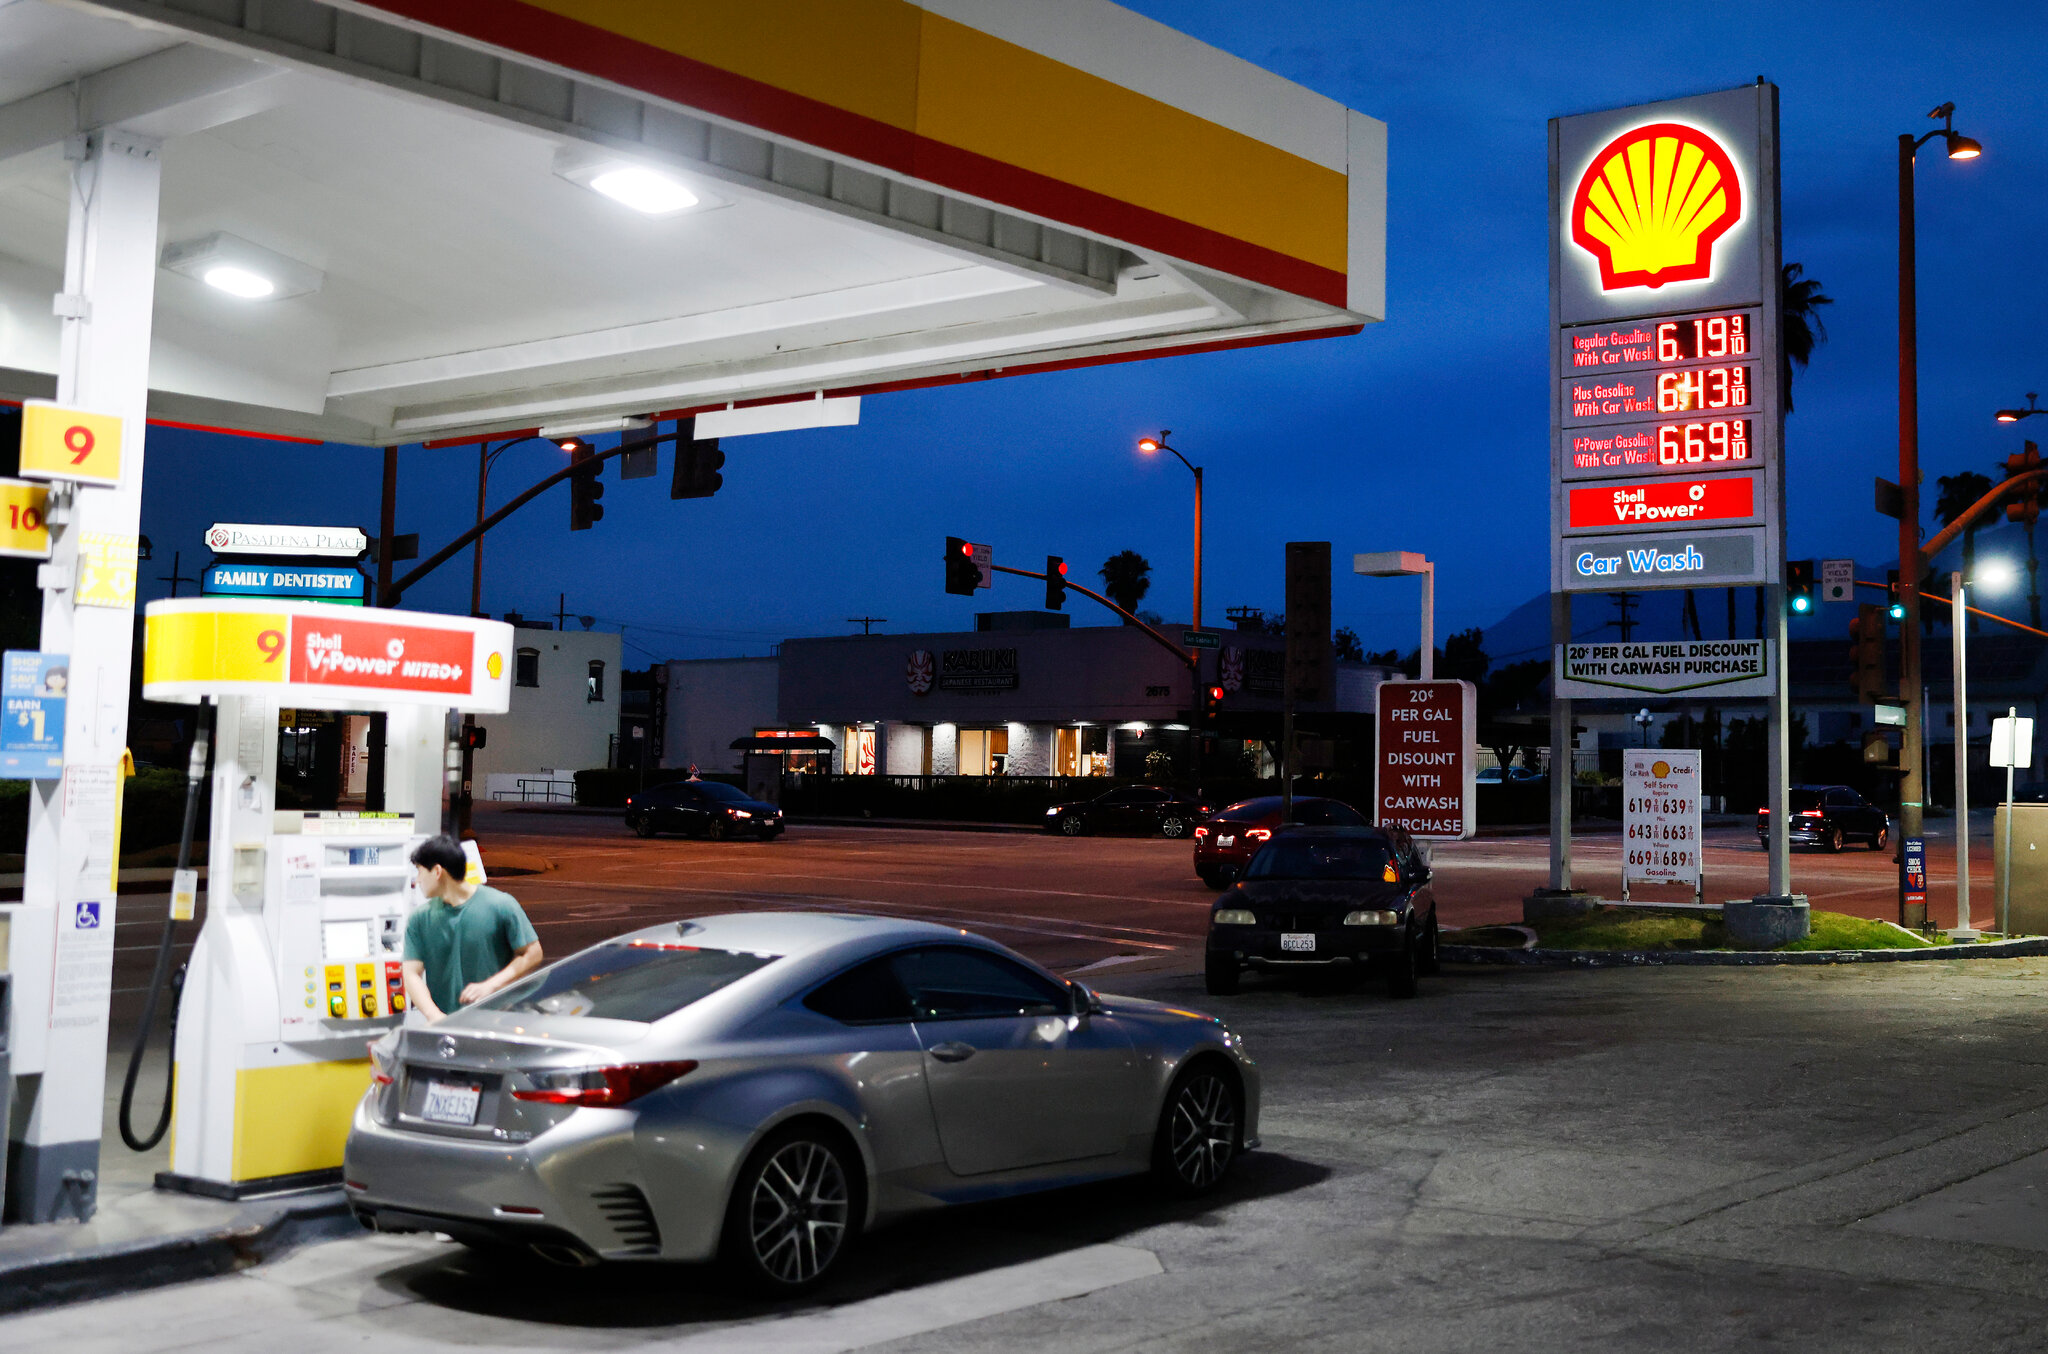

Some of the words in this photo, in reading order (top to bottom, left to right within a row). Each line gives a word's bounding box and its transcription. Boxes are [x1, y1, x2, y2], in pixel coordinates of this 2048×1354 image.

[1573, 335, 1608, 352] Regular
[1610, 329, 1652, 345] Gasoline
[1573, 352, 1599, 367] With
[1602, 351, 1620, 364] Car
[1623, 346, 1654, 362] Wash
[1573, 385, 1592, 400] Plus
[1594, 383, 1635, 398] Gasoline
[1573, 402, 1599, 417] With
[1602, 401, 1620, 414] Car
[1623, 396, 1654, 412] Wash
[64, 425, 95, 465] 9
[1573, 436, 1613, 452] V-Power
[1615, 432, 1655, 448] Gasoline
[1574, 453, 1600, 468] With
[1603, 452, 1621, 466] Car
[1624, 448, 1656, 464] Wash
[1613, 489, 1645, 503] Shell
[9, 504, 42, 531] 10
[1614, 504, 1698, 521] V-Power
[232, 531, 309, 547] PASADENA
[316, 534, 364, 549] PLACE
[1577, 552, 1622, 576] Car
[1627, 545, 1704, 573] Wash
[214, 571, 269, 586] FAMILY
[273, 573, 353, 589] DENTISTRY
[257, 629, 285, 663] 9
[306, 632, 342, 650] Shell
[1593, 646, 1618, 659] PER
[1622, 646, 1648, 658] GAL
[1652, 644, 1685, 658] FUEL
[1689, 643, 1759, 657] DISCOUNT
[307, 650, 395, 676] V-Power
[1572, 663, 1607, 675] WITH
[1610, 661, 1680, 675] CARWASH
[1684, 660, 1758, 674] PURCHASE
[1410, 689, 1434, 703] 20¢
[8, 699, 41, 710] EARN
[1392, 709, 1418, 721] PER
[1423, 708, 1453, 721] GAL
[1403, 731, 1440, 743] FUEL
[1388, 752, 1456, 765] DISOUNT
[1402, 775, 1441, 787] WITH
[1644, 781, 1658, 789] Self
[1384, 796, 1459, 810] CARWASH
[1629, 798, 1652, 814] 619
[1663, 799, 1686, 814] 639
[1629, 824, 1652, 839] 643
[1663, 825, 1686, 840] 663
[1629, 850, 1652, 865] 669
[1663, 851, 1686, 866] 689
[1646, 868, 1676, 876] Gasoline
